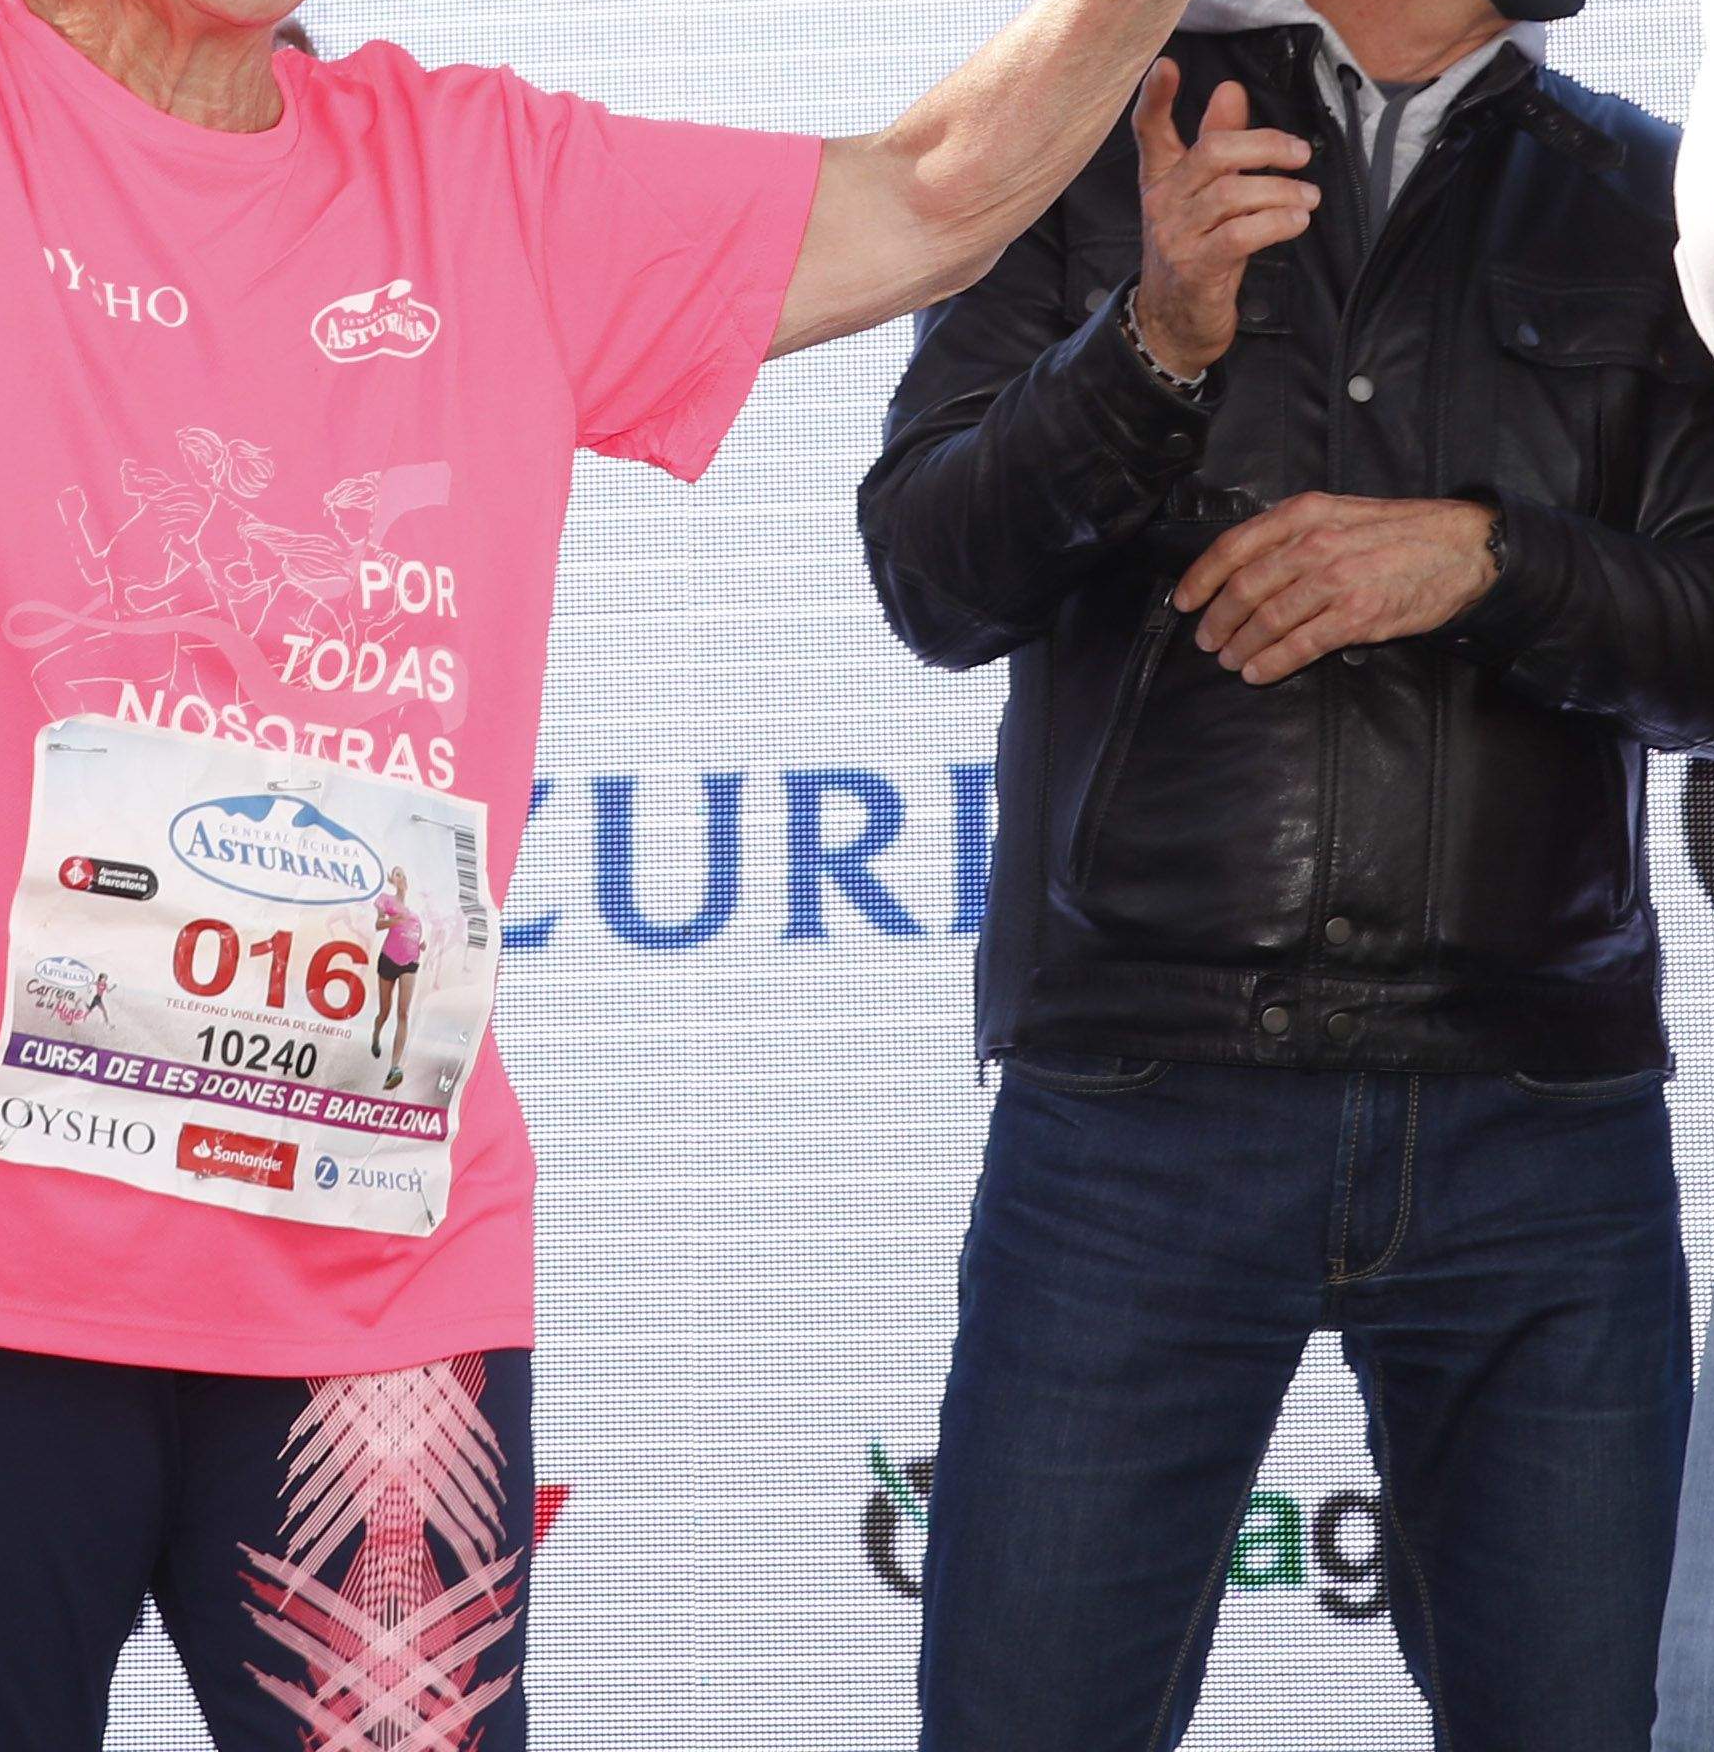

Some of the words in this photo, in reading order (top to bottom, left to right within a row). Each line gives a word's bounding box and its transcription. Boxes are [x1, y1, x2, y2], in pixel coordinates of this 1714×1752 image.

[360, 560, 458, 618] POR
[279, 633, 455, 704] TODAS
[115, 682, 456, 790] NOSOTRAS
[97, 876, 148, 893] Barcelona
[186, 820, 369, 891] ASTURIANA
[26, 978, 76, 1002] Carrera
[172, 918, 369, 1022] 016
[165, 997, 229, 1018] TELÉFONO
[230, 1007, 291, 1028] VIOLENCIA
[308, 1020, 353, 1040] GÉNERO
[197, 1025, 317, 1080] 10240
[19, 1040, 99, 1076] CURSA
[104, 1056, 144, 1084] DE
[145, 1063, 199, 1094] LES
[200, 1073, 287, 1110] DONES
[288, 1089, 324, 1116] DE
[323, 1097, 442, 1136] BARCELONA
[1, 1097, 156, 1156] OYSHO
[213, 1145, 283, 1172] Santander
[347, 1166, 424, 1193] ZURICH
